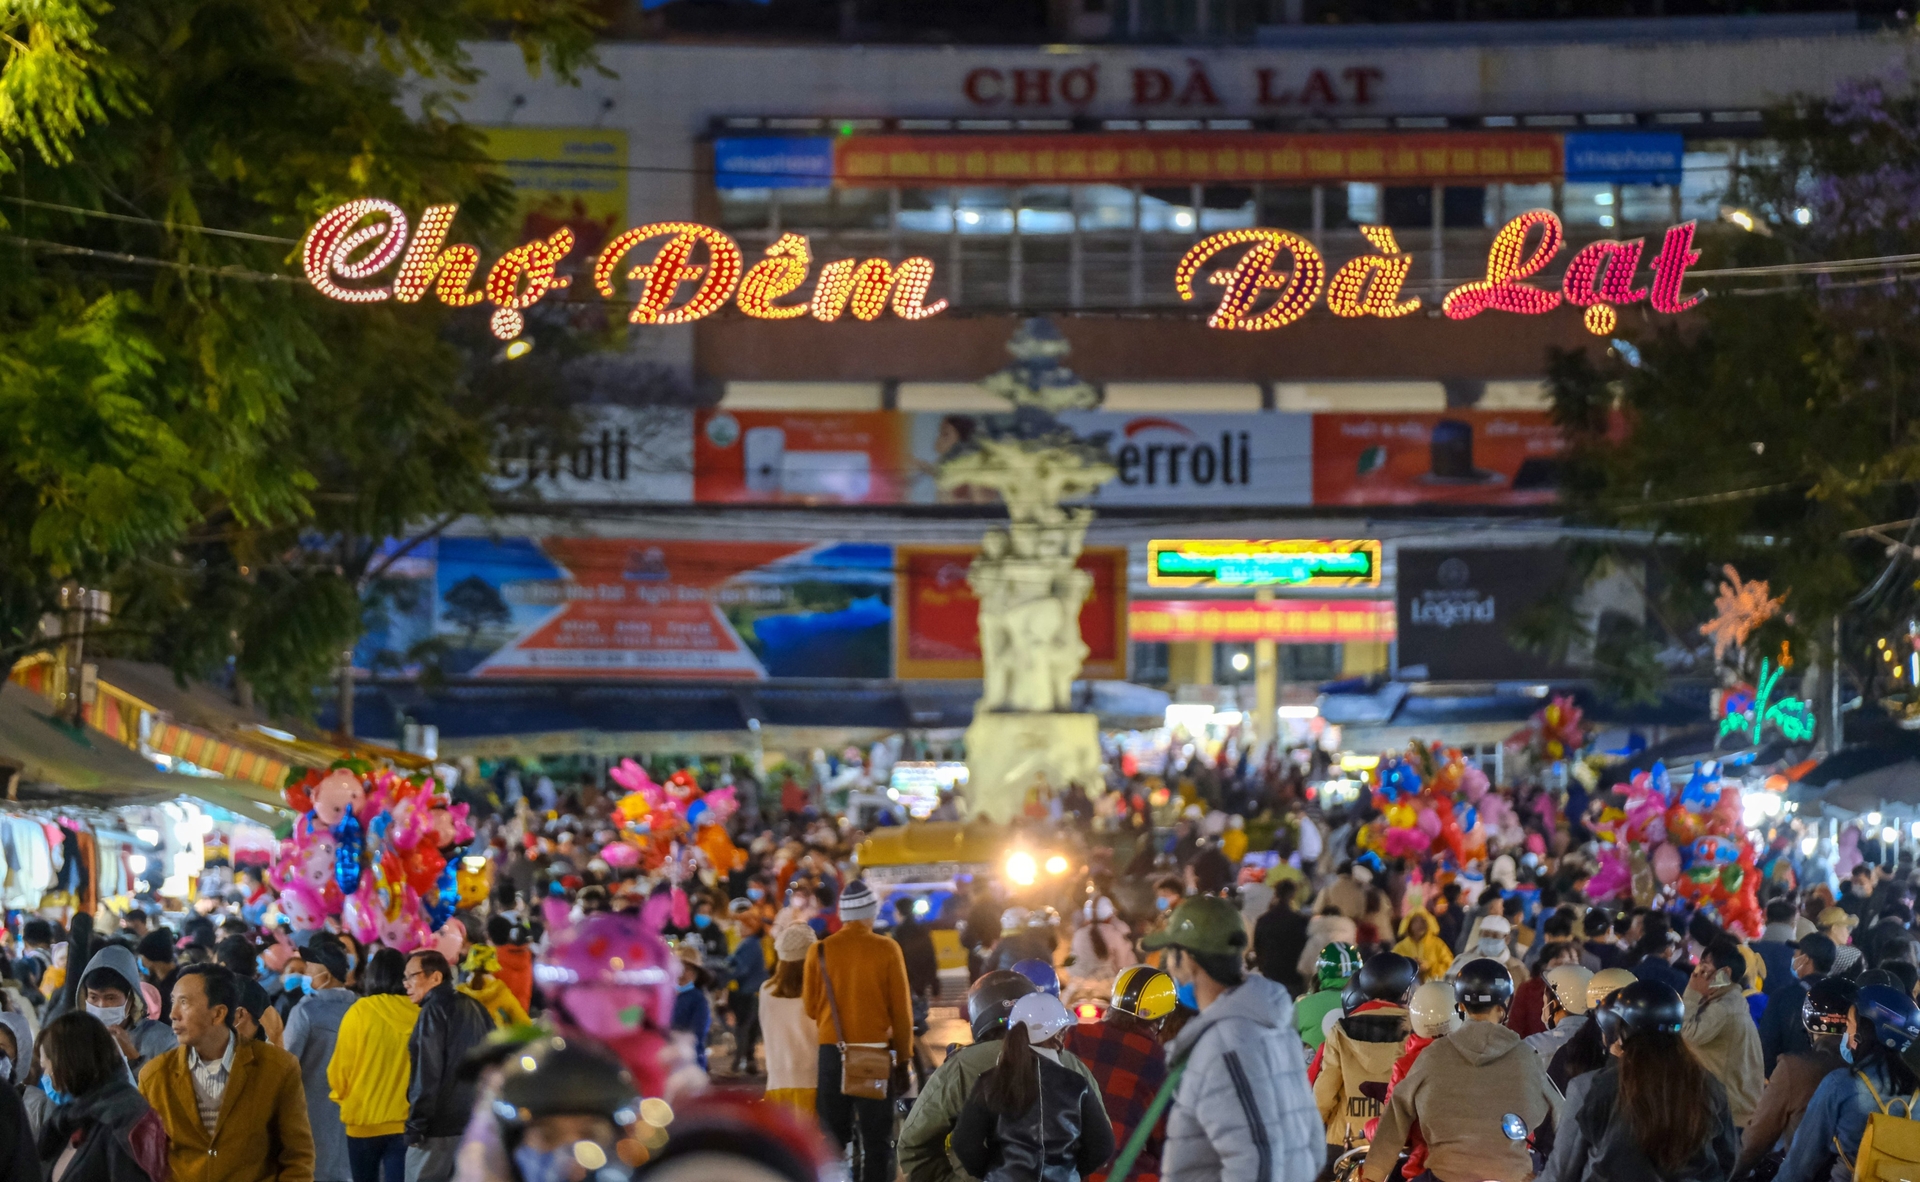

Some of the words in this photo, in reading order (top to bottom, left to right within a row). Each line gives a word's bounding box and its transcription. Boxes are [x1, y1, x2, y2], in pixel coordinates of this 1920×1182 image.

[1131, 58, 1220, 107] ĐÀ
[302, 198, 573, 340] Chợ
[594, 221, 950, 325] Đêm
[1174, 224, 1423, 332] Đà
[1442, 208, 1709, 336] Lạt
[497, 426, 629, 481] erroli
[1117, 430, 1252, 485] erroli
[1410, 595, 1496, 627] Legend
